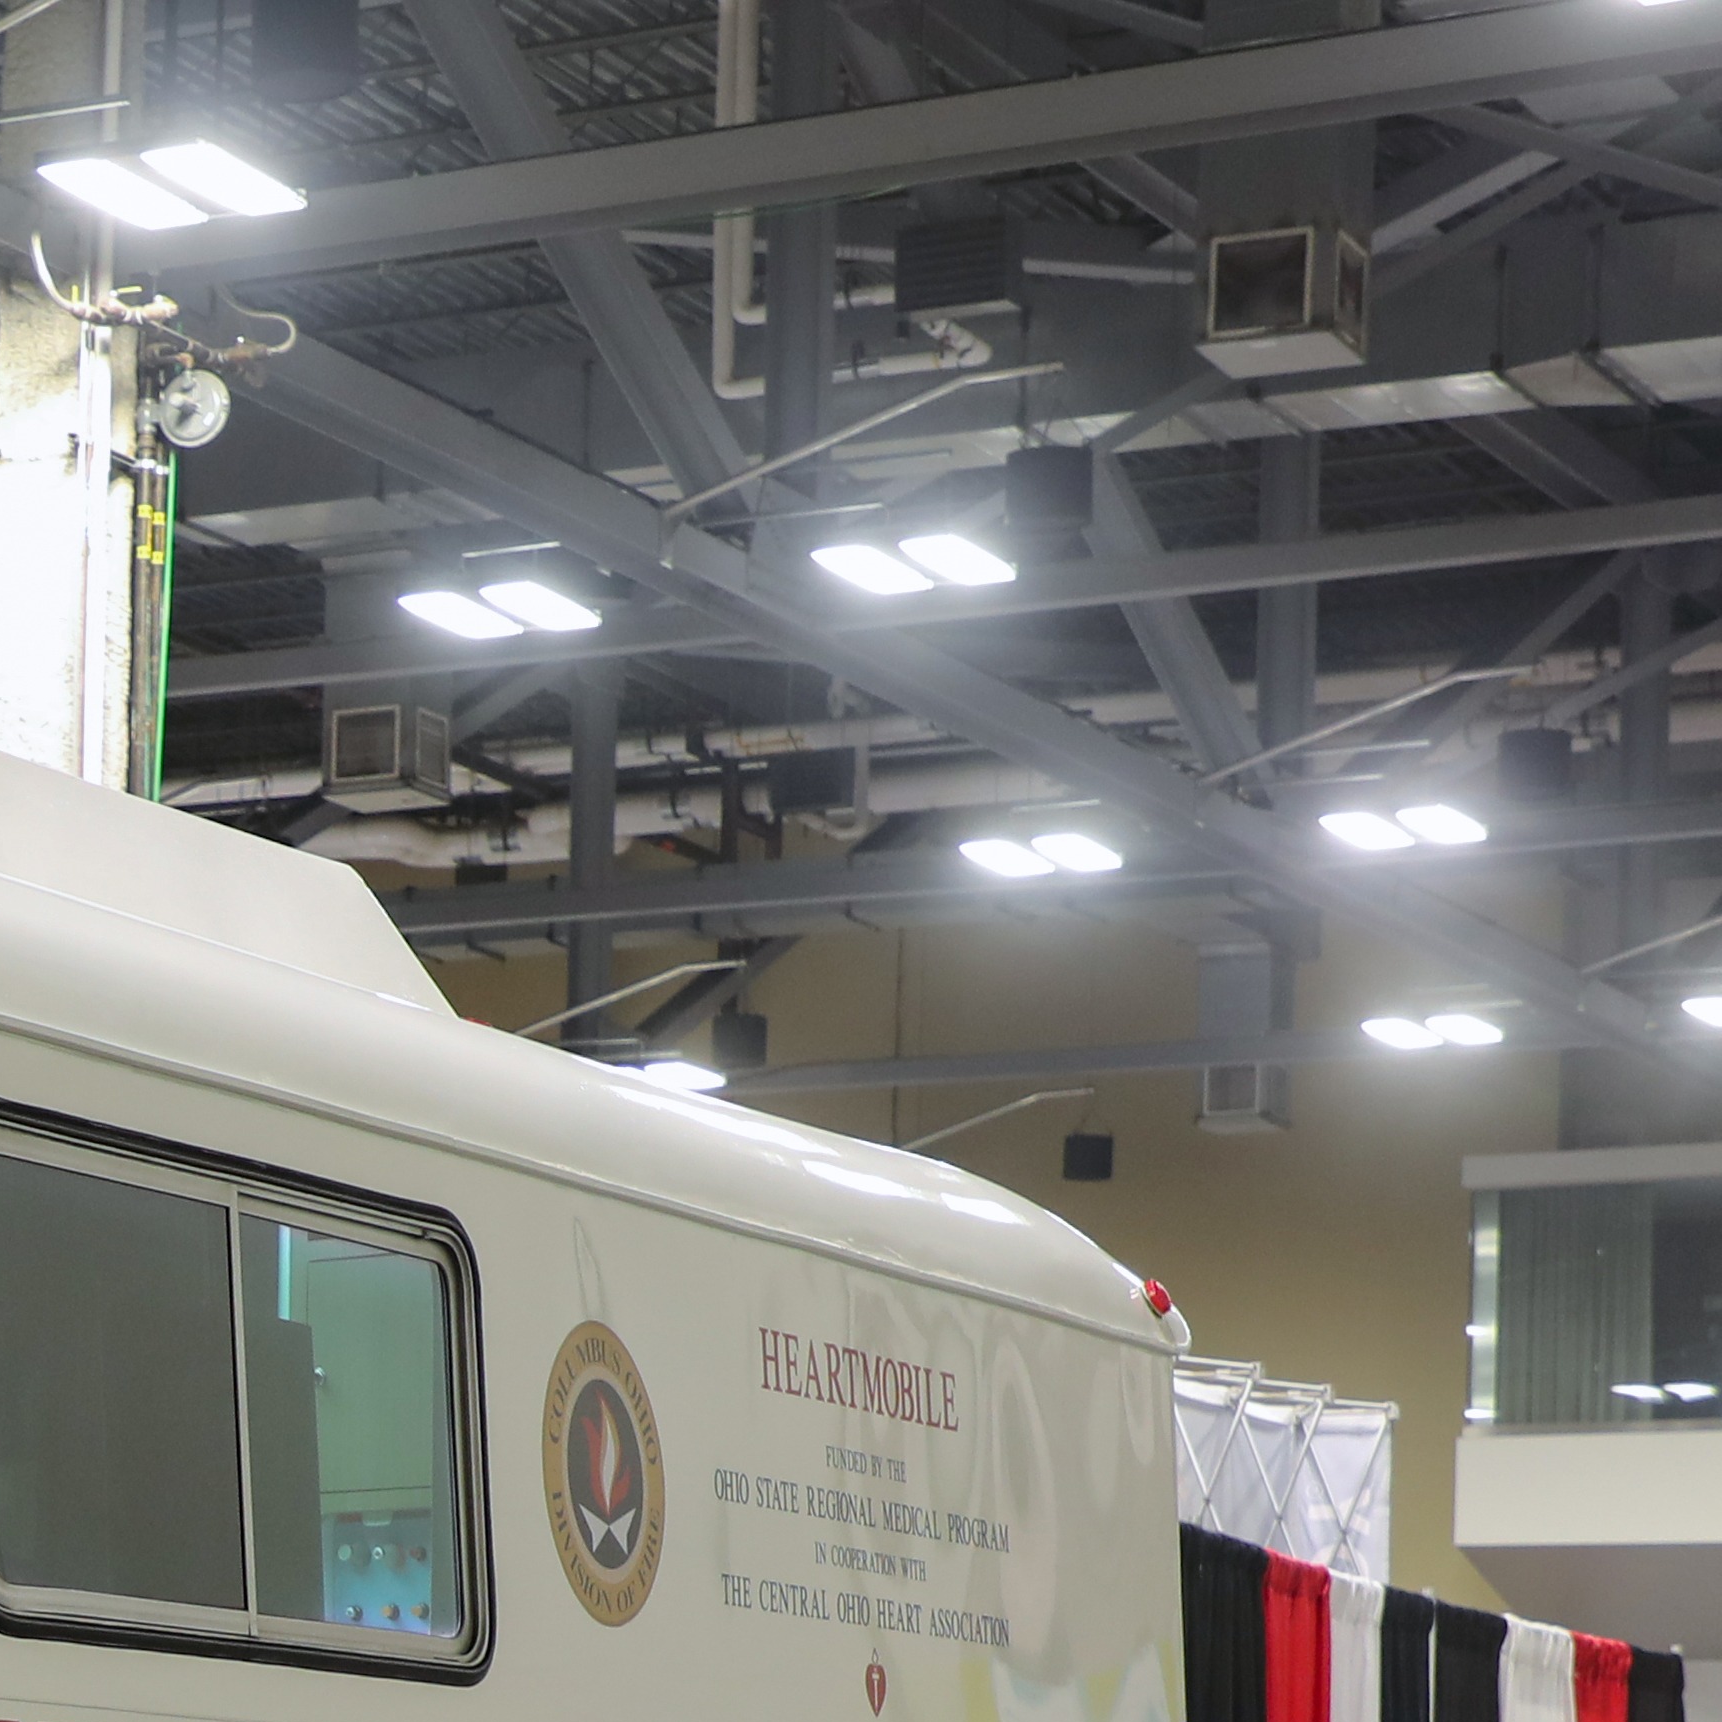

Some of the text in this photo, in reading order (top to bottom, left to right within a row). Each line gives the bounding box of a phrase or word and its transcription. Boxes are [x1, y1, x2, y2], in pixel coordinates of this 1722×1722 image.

[549, 1338, 658, 1465] COLUMBUS OHIO
[759, 1327, 959, 1432] HEARTMOBILE
[826, 1446, 907, 1483] FUNDED BY THE
[552, 1492, 661, 1613] DIVISION OF FIRE
[714, 1469, 1010, 1553] OHIO STATE REGIONAL MEDICAL PROGRAM
[814, 1542, 927, 1581] IN COOPERATION WITH
[721, 1573, 1010, 1647] THE CENTRAL OHIO HEART ASSOCIATION
